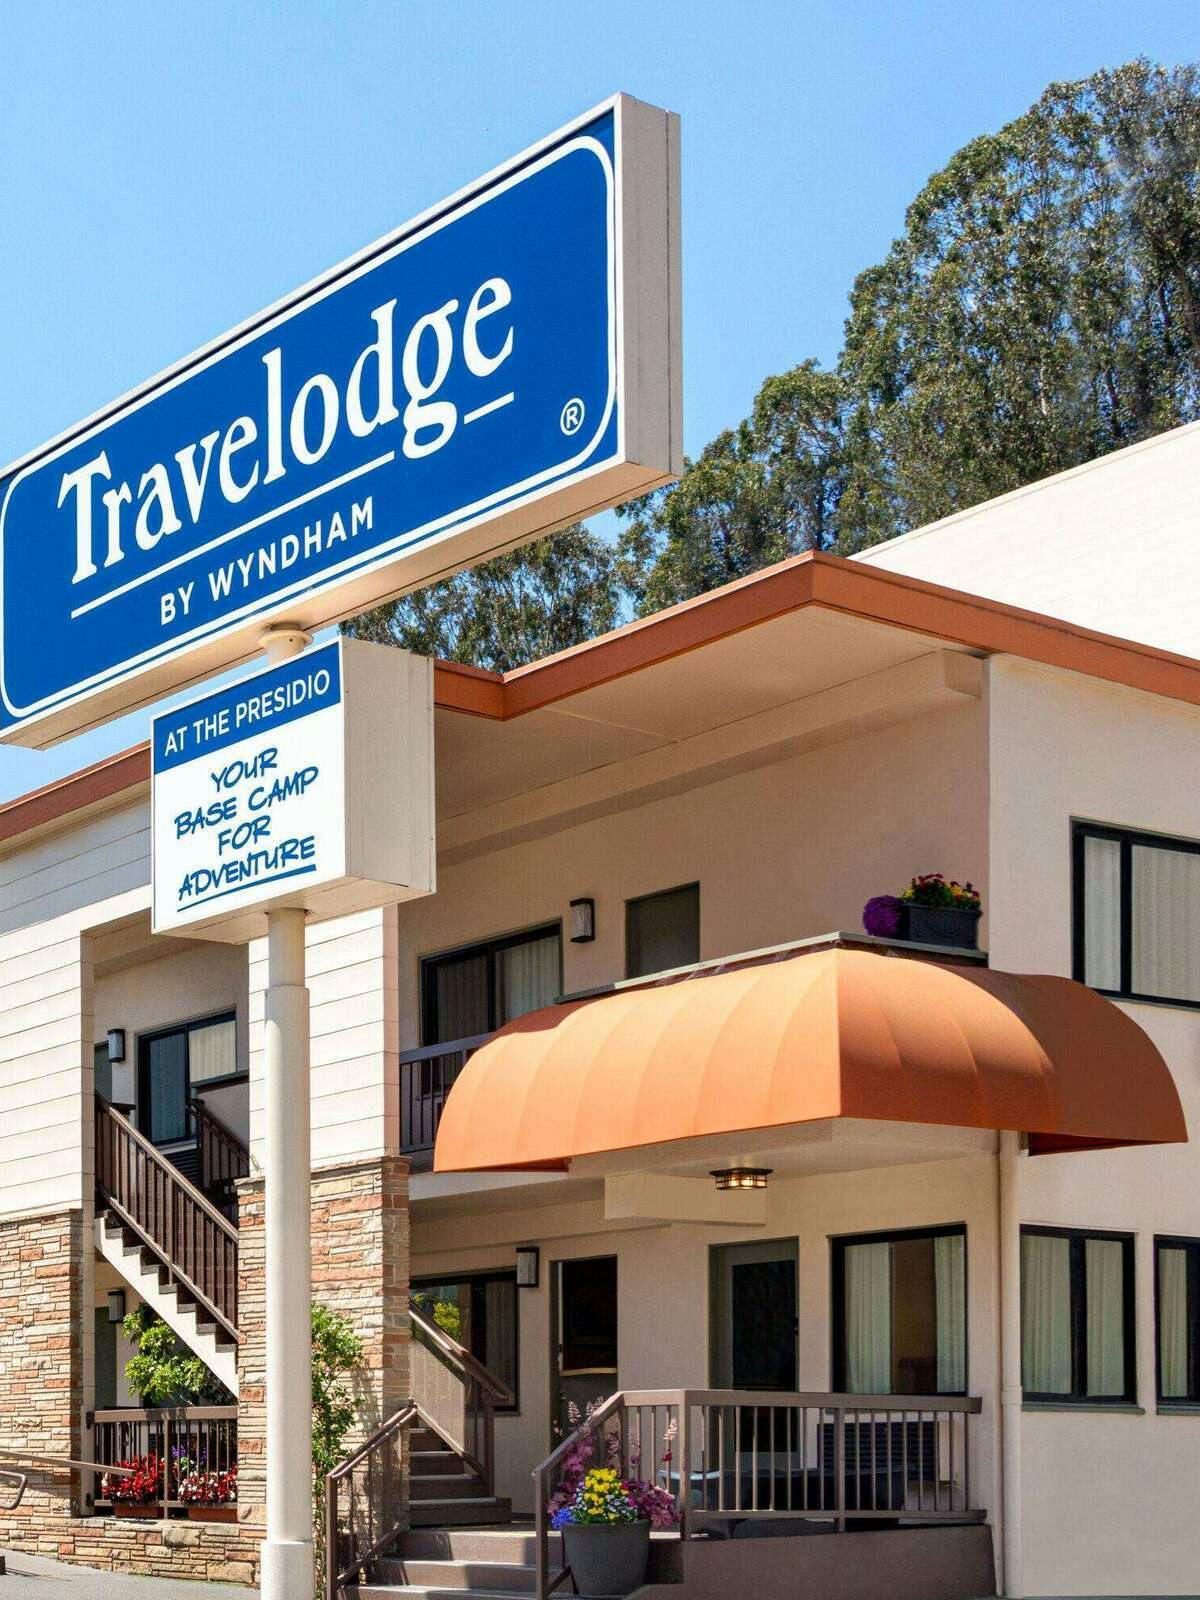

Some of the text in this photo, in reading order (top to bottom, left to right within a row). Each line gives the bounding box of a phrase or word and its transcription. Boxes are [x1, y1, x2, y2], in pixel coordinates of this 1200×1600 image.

[57, 277, 514, 585] Travelodge
[160, 496, 373, 625] BY WYNDHAM
[164, 669, 330, 757] AT THE PRESIDIO
[174, 766, 319, 840] BASE CAMP
[210, 747, 278, 793] YOUR
[178, 835, 316, 901] ADVENTURE
[217, 815, 271, 856] FOR
